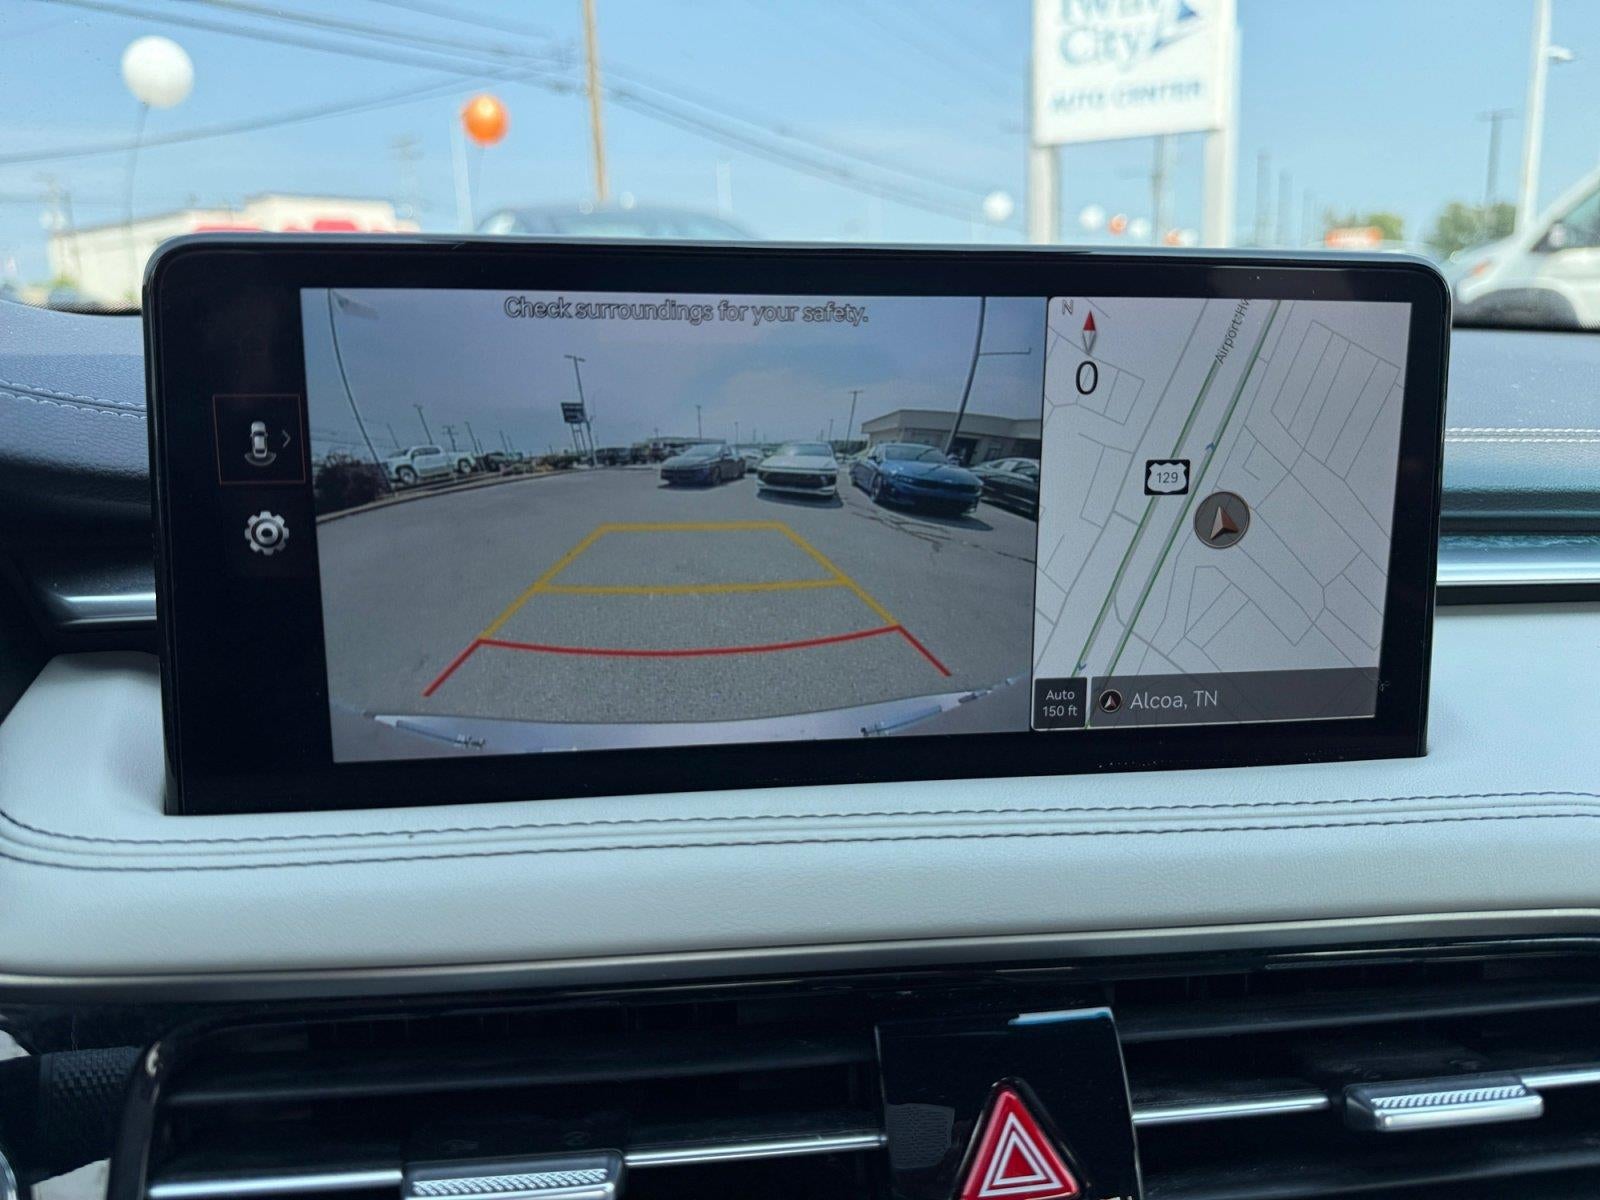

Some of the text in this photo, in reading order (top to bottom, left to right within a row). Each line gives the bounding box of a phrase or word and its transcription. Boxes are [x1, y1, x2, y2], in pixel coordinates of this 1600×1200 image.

[1059, 25, 1139, 72] City
[504, 296, 869, 326] Check surroundings for your safety.
[1062, 298, 1074, 315] N
[1215, 317, 1243, 364] Airport
[1075, 360, 1099, 395] 0
[1156, 471, 1179, 484] 129
[1045, 689, 1076, 701] Auto
[1128, 690, 1219, 710] Alcoa, TN
[1042, 704, 1078, 718] 150 ft
